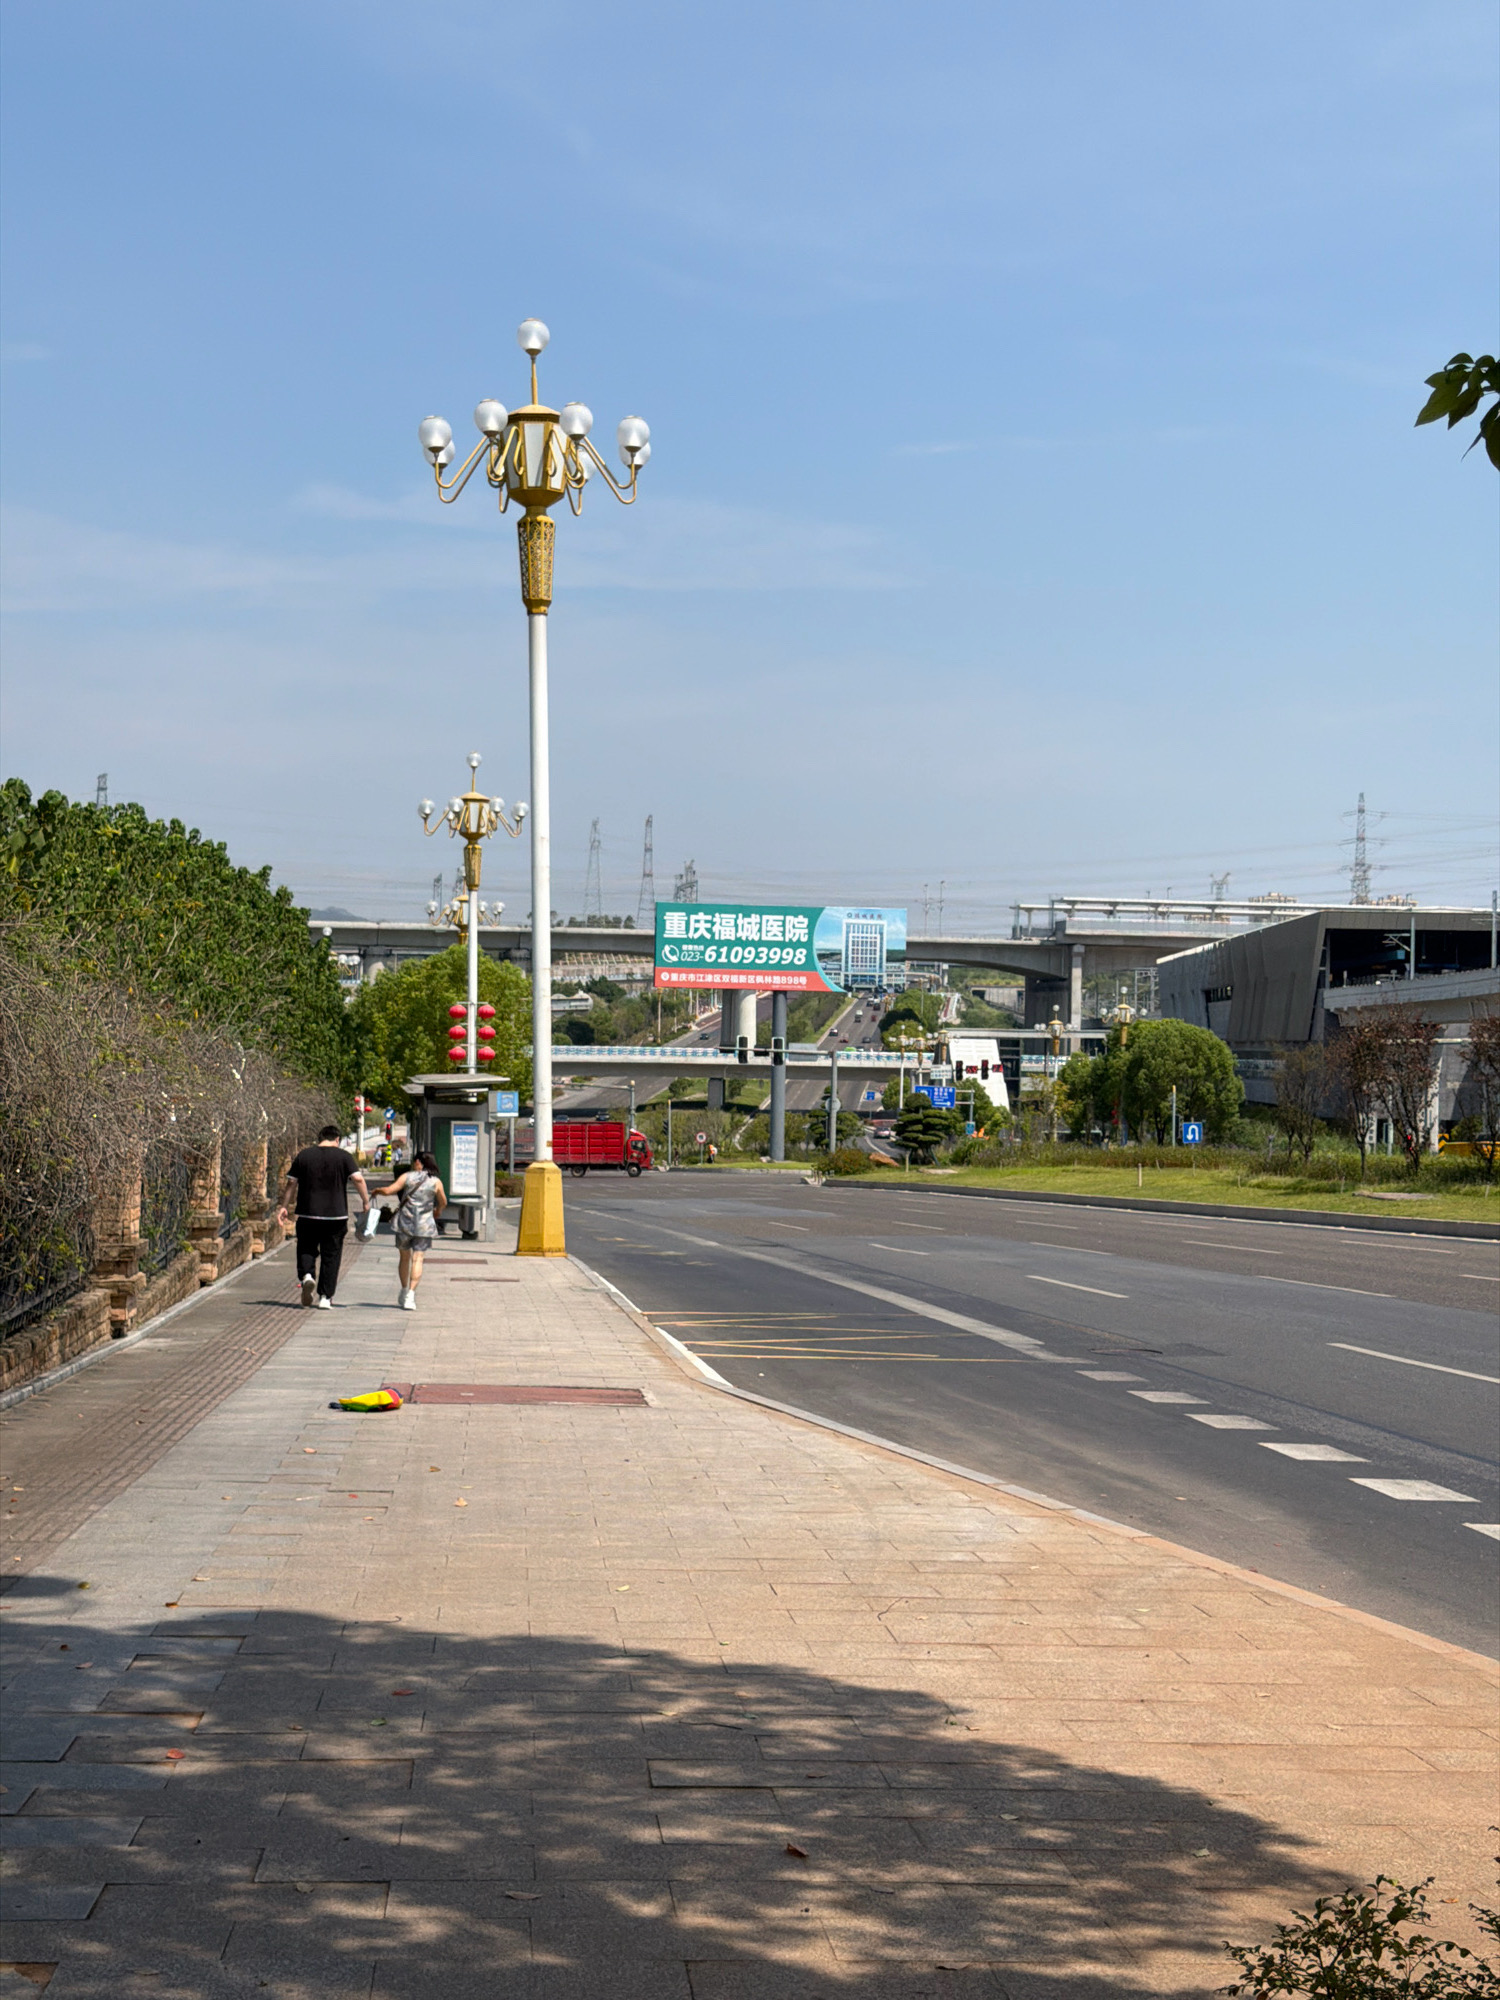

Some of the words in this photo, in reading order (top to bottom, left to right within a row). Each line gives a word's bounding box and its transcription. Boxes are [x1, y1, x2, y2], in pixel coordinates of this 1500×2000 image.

[663, 911, 809, 942] 重庆福城医院
